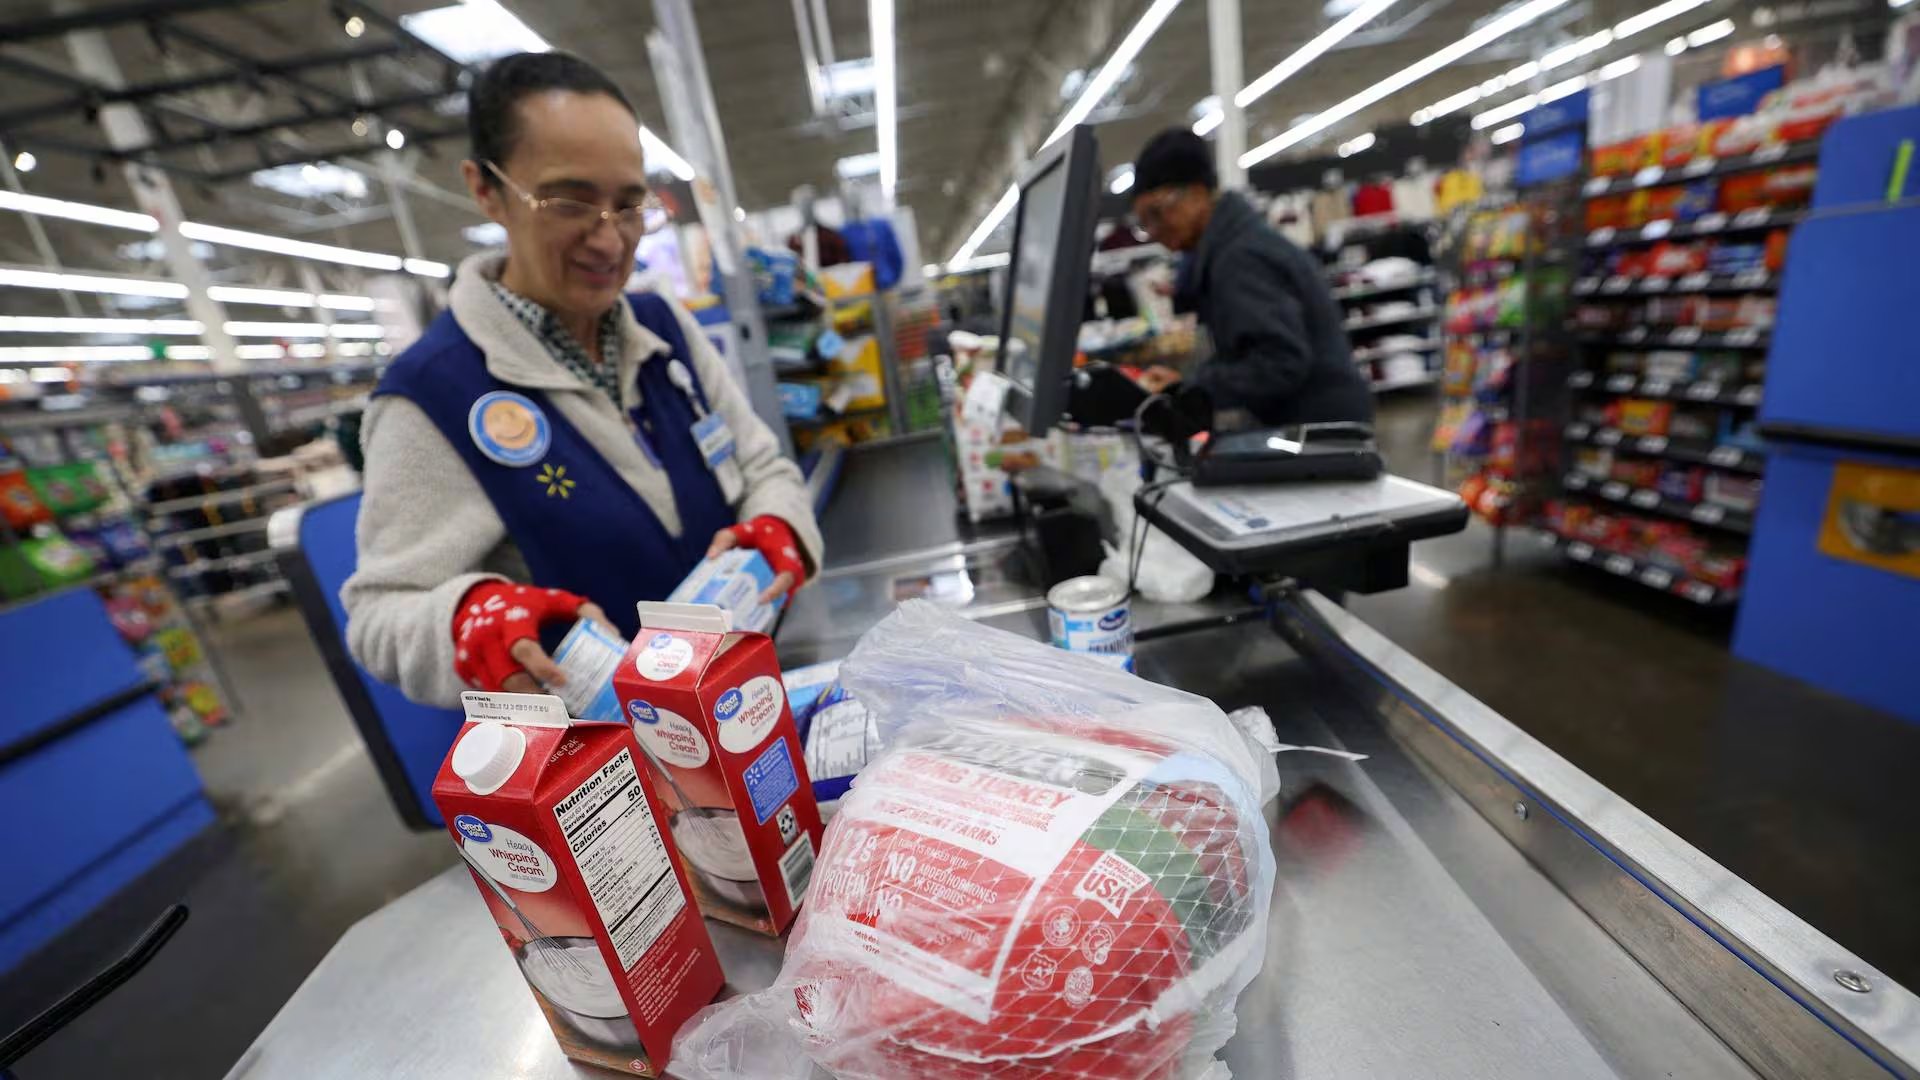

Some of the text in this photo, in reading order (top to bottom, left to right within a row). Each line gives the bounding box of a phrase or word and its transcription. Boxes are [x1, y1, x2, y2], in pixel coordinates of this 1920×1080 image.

[738, 692, 774, 724] Whipping
[750, 703, 775, 727] Cream
[655, 729, 696, 746] Whipping
[668, 740, 699, 754] Cream
[550, 738, 578, 762] ure-Pak
[555, 752, 630, 818] Nutrition Facts
[581, 792, 600, 810] servings
[457, 819, 485, 832] Great
[564, 811, 586, 832] Serving
[585, 803, 597, 815] size
[573, 785, 641, 853] Calories 50
[950, 821, 1001, 846] FARMS
[488, 848, 540, 867] Whipping
[506, 838, 534, 856] Heavy
[507, 861, 545, 877] Cream
[580, 857, 592, 870] Total
[592, 849, 600, 859] Fat
[886, 852, 915, 883] NO
[589, 865, 613, 891] Cholesterol
[593, 881, 608, 897] Sodium
[596, 890, 607, 903] Total
[606, 866, 633, 893] Carbohydrate
[918, 862, 998, 904] ADDED HORMONES
[1083, 872, 1128, 910] USA
[608, 913, 623, 929] Protein
